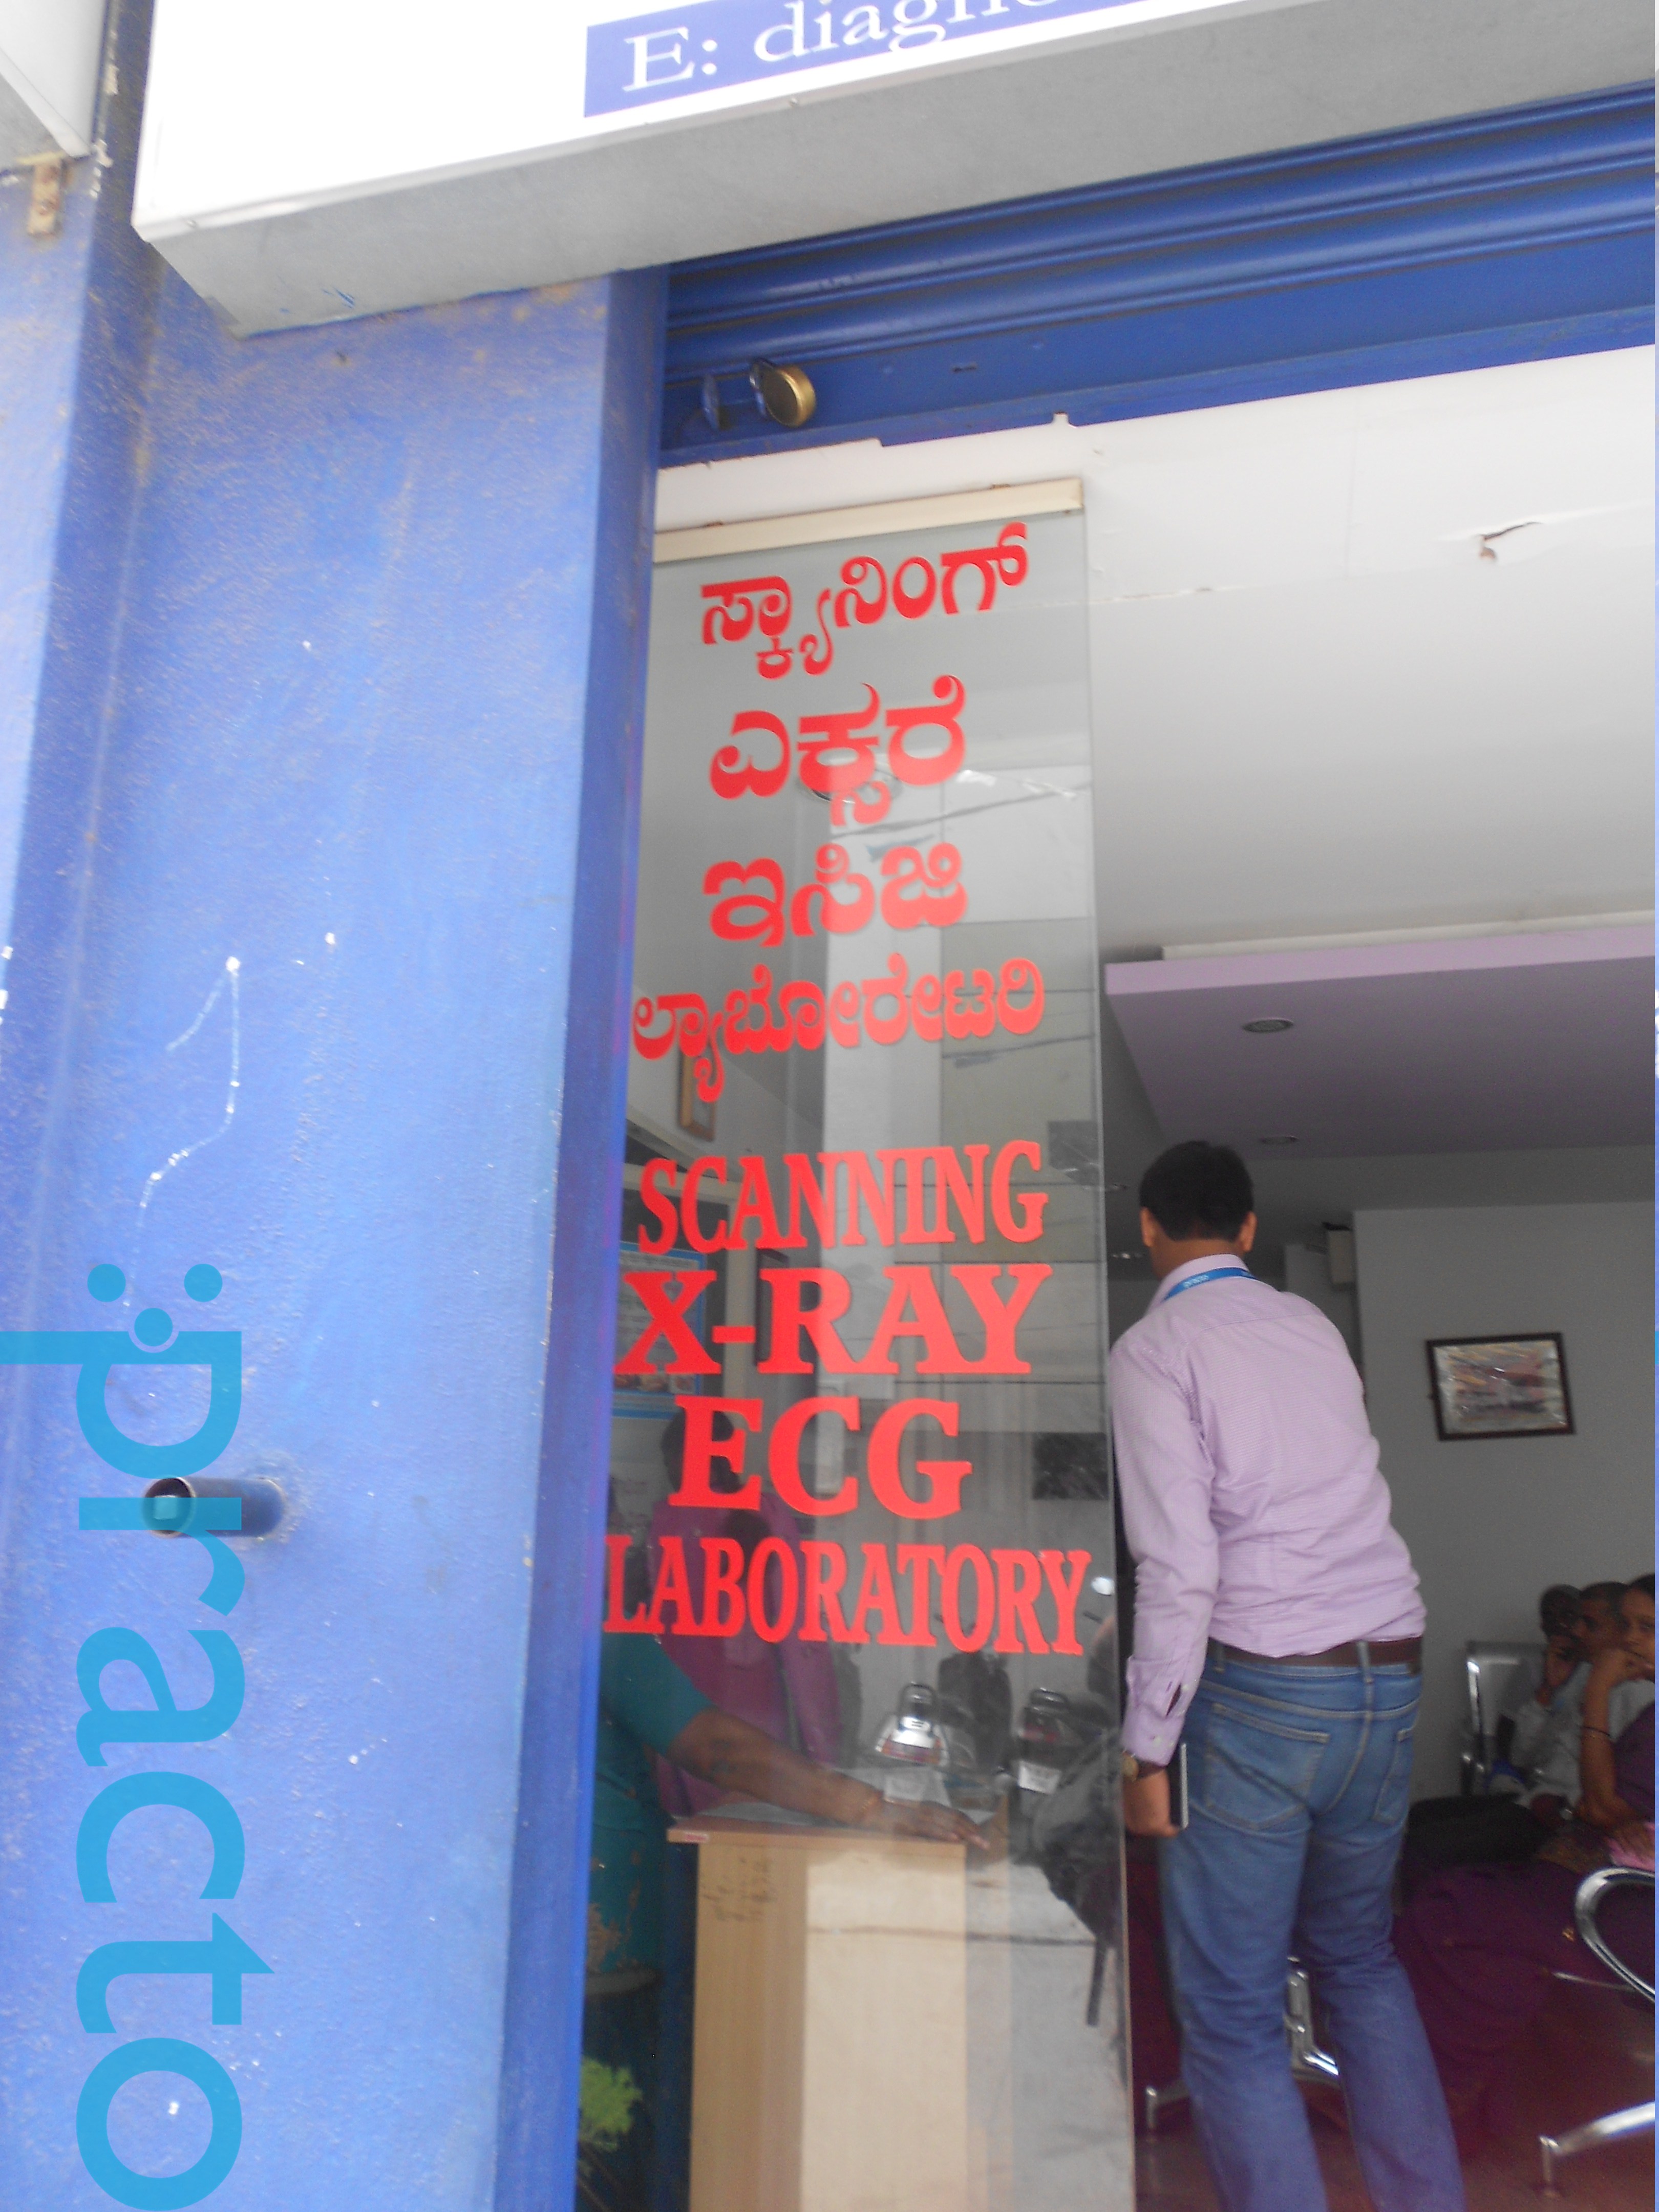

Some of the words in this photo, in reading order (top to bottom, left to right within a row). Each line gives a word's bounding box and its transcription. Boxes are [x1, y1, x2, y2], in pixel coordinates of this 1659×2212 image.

[622, 27, 718, 93] E:
[753, 0, 1064, 62] diagn
[701, 522, 1029, 679] ಸ್ಕ್ಯಾನಿಂಗ್
[702, 843, 968, 947] ಇಸಿಜಿ
[632, 953, 1044, 1103] ಲ್ಯಾಬೋರೇಟರಿ
[638, 1140, 1049, 1255] SCANNING
[613, 1263, 1053, 1375] X-RAY
[669, 1395, 972, 1520] ECG
[603, 1535, 1091, 1656] LABORATORY
